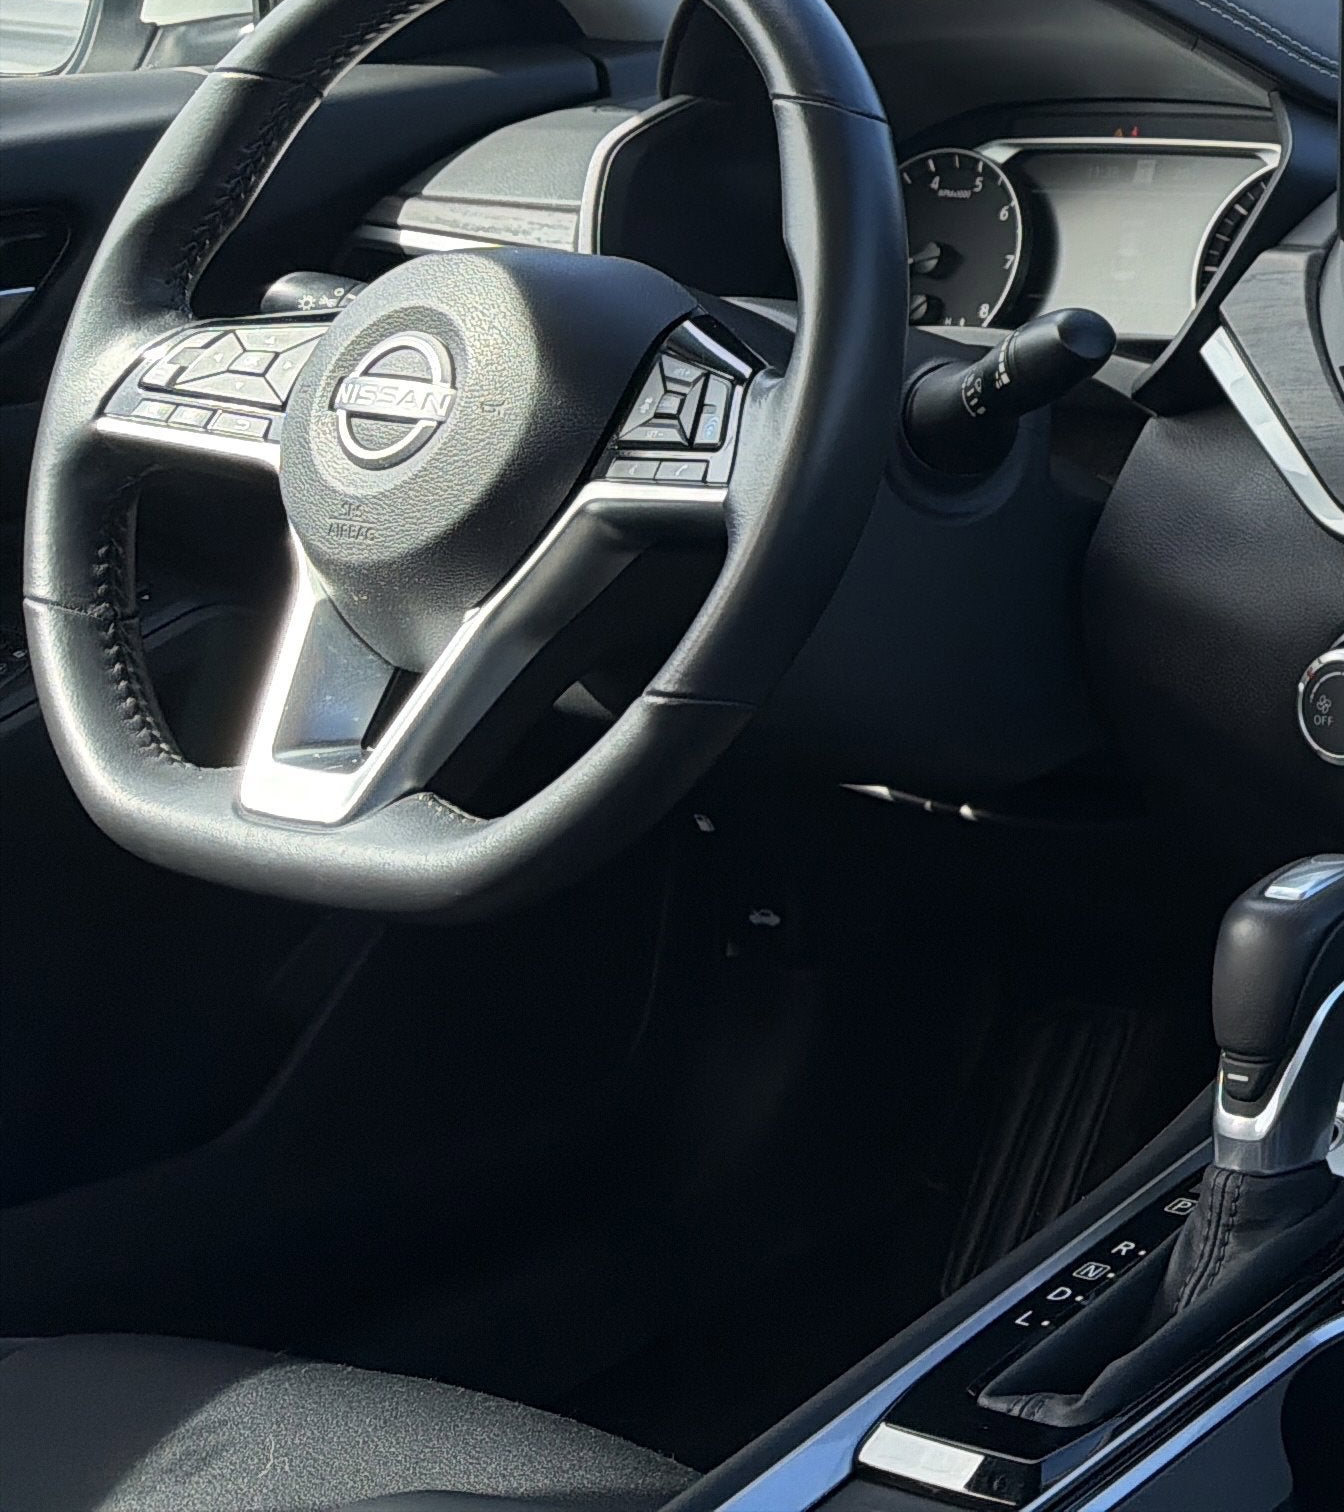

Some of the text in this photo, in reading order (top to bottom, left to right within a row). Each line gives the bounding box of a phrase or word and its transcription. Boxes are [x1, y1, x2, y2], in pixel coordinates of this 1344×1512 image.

[931, 176, 940, 190] 4
[973, 176, 983, 192] 5
[999, 205, 1009, 221] 6
[1005, 254, 1015, 269] 7
[979, 303, 990, 319] 8
[337, 383, 451, 418] NISSAN
[1313, 714, 1334, 727] OFF
[1112, 1241, 1135, 1256] R
[1046, 1287, 1072, 1301] D
[1015, 1311, 1031, 1327] L
